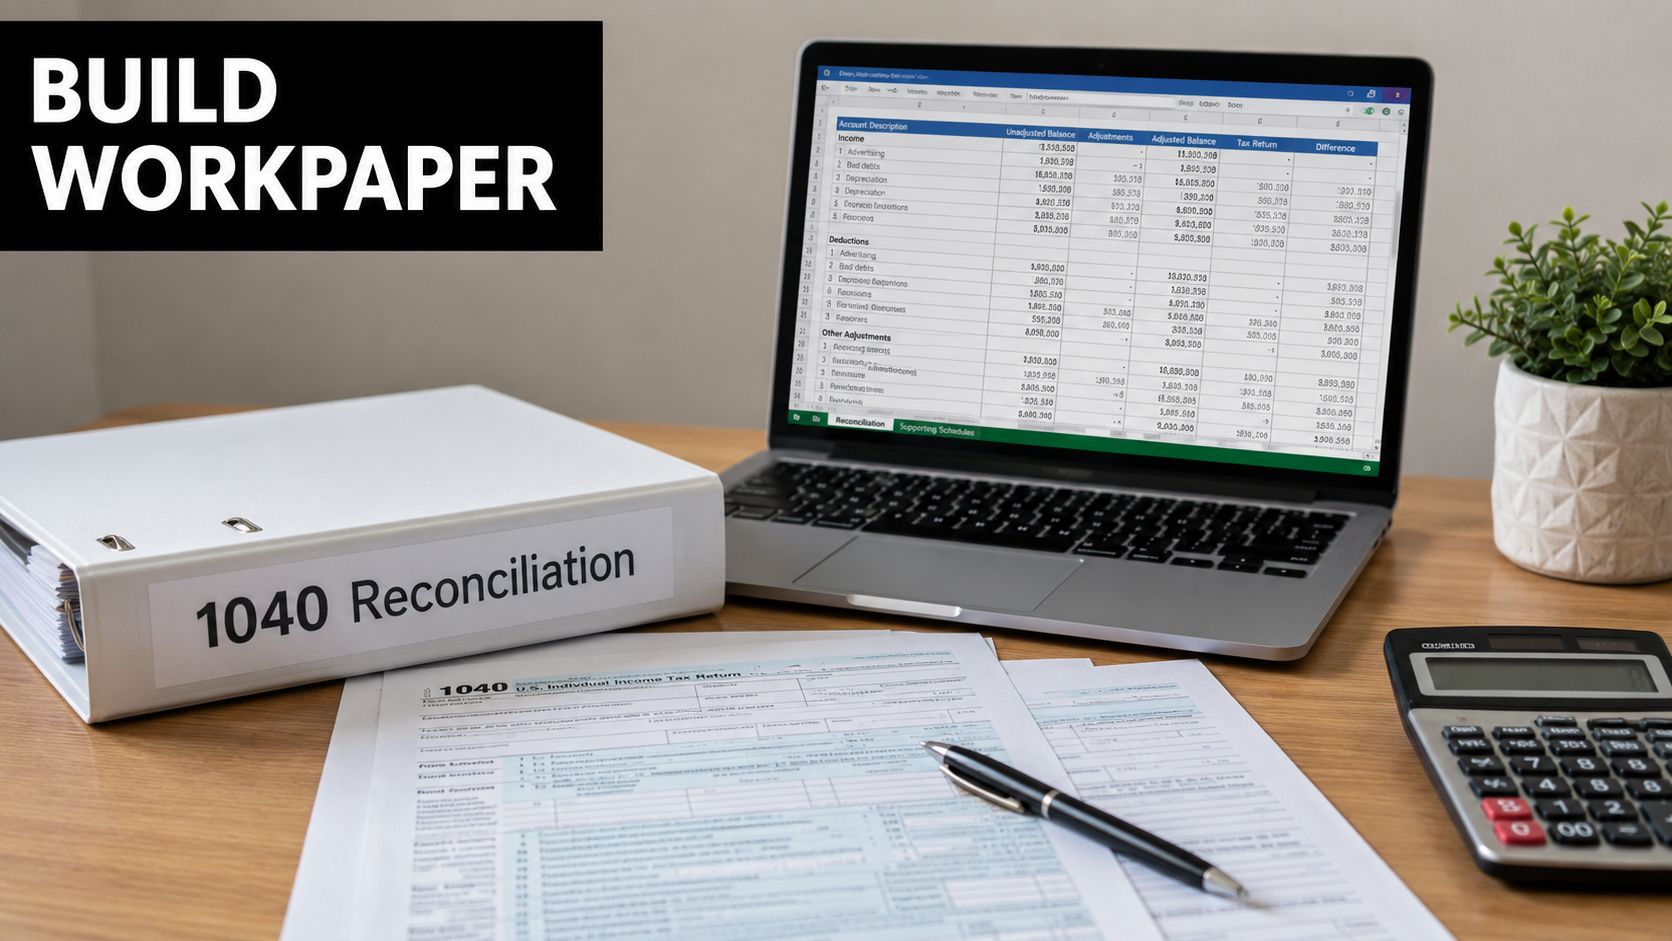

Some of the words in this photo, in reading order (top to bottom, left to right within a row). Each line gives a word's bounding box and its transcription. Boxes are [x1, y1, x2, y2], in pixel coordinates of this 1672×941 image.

[838, 120, 868, 129] Account
[869, 122, 908, 132] Description
[838, 134, 865, 143] Income
[1006, 128, 1046, 139] Unadjusted
[1047, 130, 1076, 139] Balance
[1087, 132, 1134, 142] Adjustments
[1151, 134, 1186, 146] Adjusted
[1187, 136, 1217, 146] Balance
[1237, 139, 1250, 147] Tax
[1252, 139, 1278, 149] Return
[1316, 143, 1356, 153] Difference
[829, 235, 870, 246] Deductions
[822, 328, 842, 338] Other
[844, 330, 892, 342] Adjustments
[835, 416, 886, 428] Reconciliation
[900, 423, 937, 435] Supporting
[939, 425, 975, 437] Schedules
[196, 586, 329, 648] 1040
[351, 545, 635, 623] Reconciliation
[615, 677, 662, 686] Income
[440, 682, 508, 696] 1040
[1524, 757, 1539, 769] 7
[1577, 758, 1596, 770] 8
[1539, 778, 1556, 791] 4
[1553, 800, 1569, 814] 1
[1604, 800, 1625, 815] 2
[1511, 822, 1531, 836] 0
[1557, 822, 1594, 837] 00
